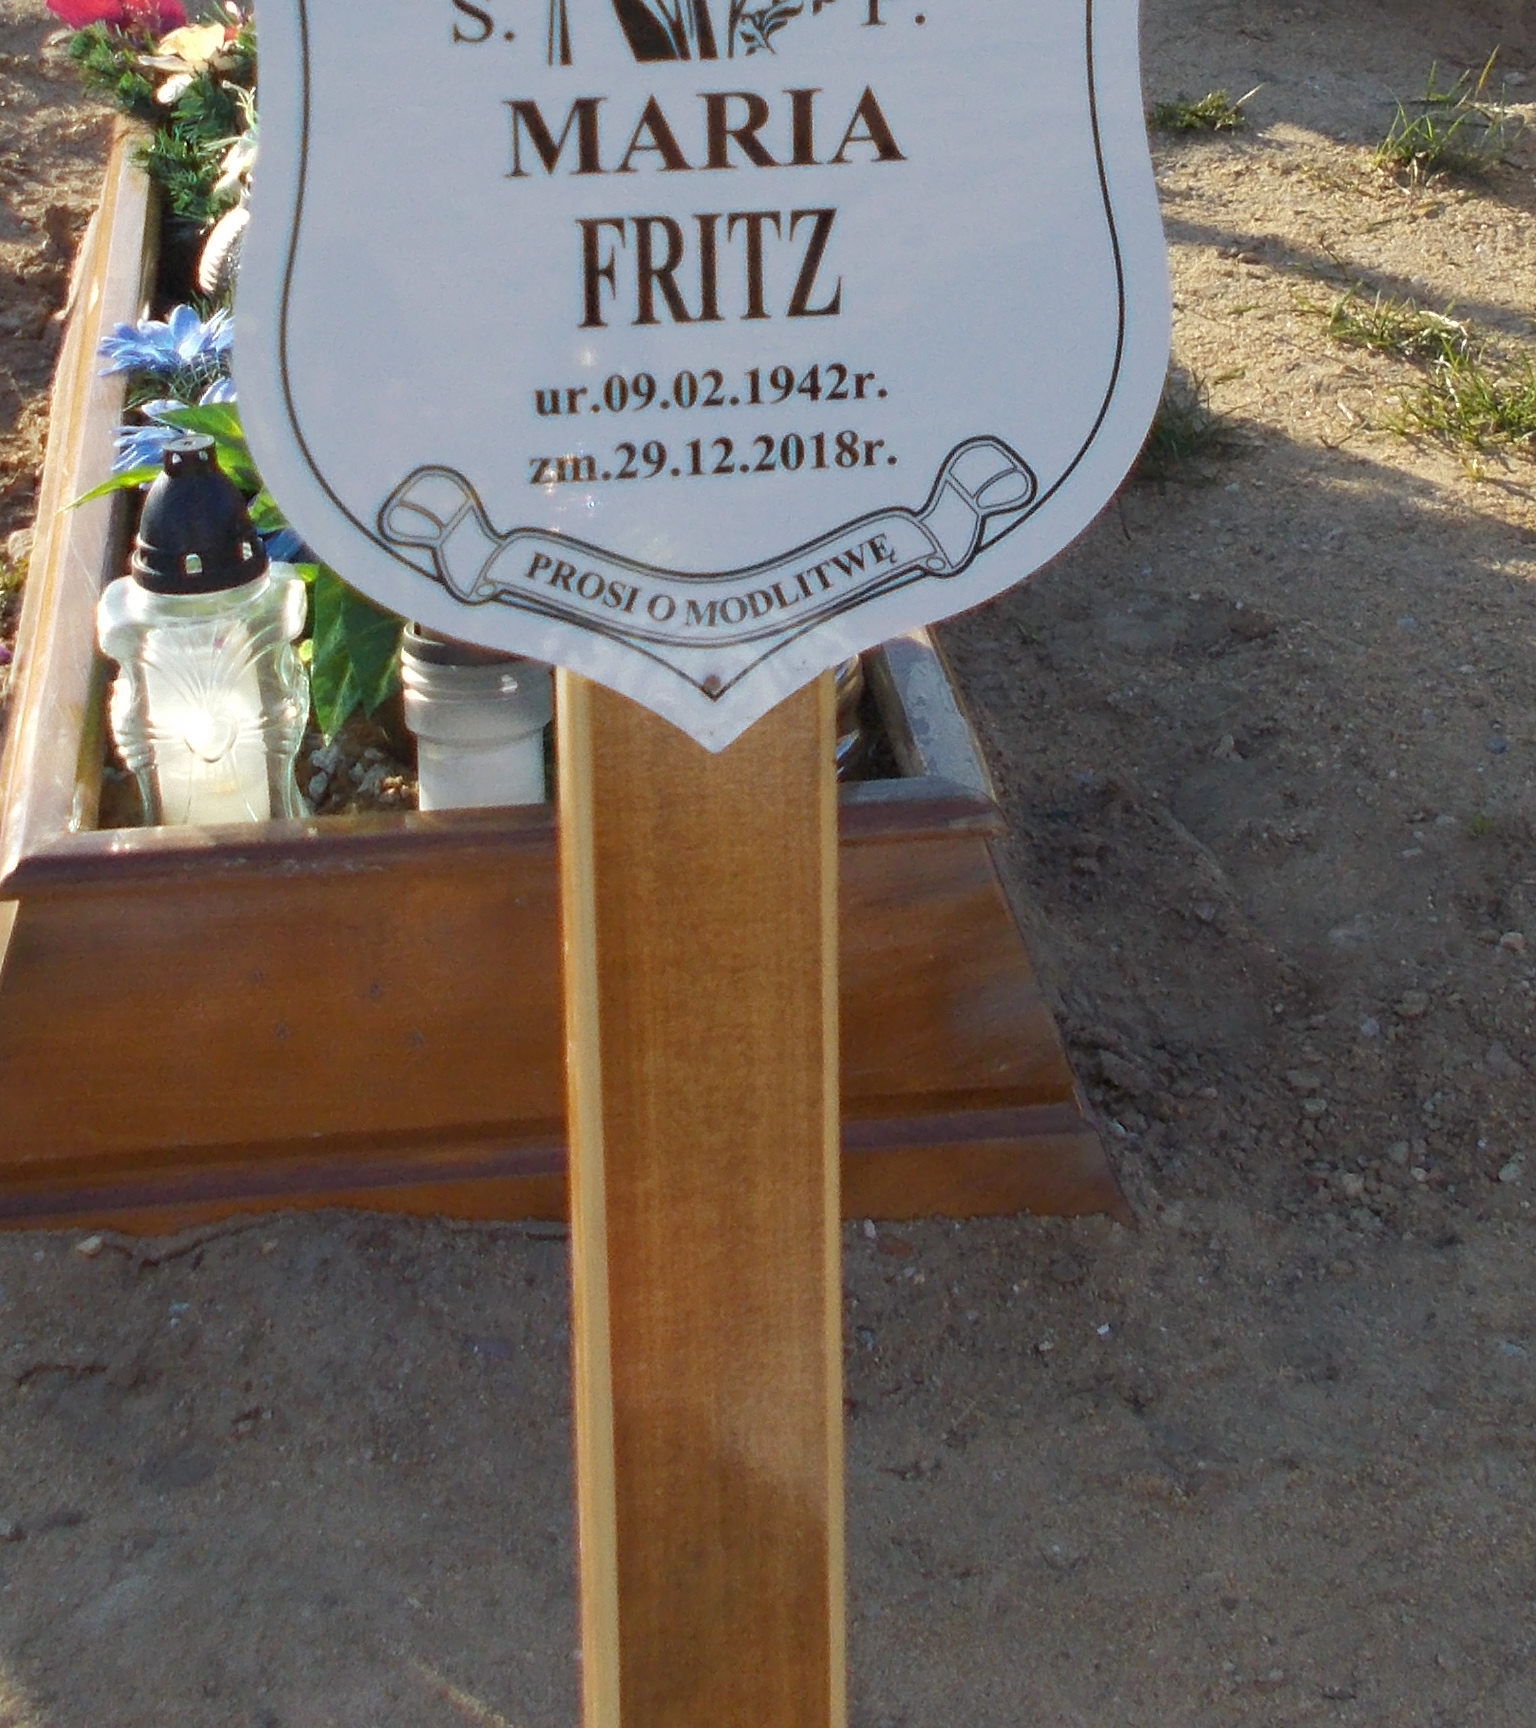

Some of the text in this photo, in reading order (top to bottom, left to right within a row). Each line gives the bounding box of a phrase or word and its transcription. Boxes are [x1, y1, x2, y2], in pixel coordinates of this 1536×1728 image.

[502, 84, 908, 178] MARIA
[574, 207, 843, 329] FRITZ
[533, 362, 889, 416] ur.09.02.1942r.
[528, 429, 899, 485] zm.29.12.2018r.
[525, 531, 898, 629] PROSI O MODLITWĘ
